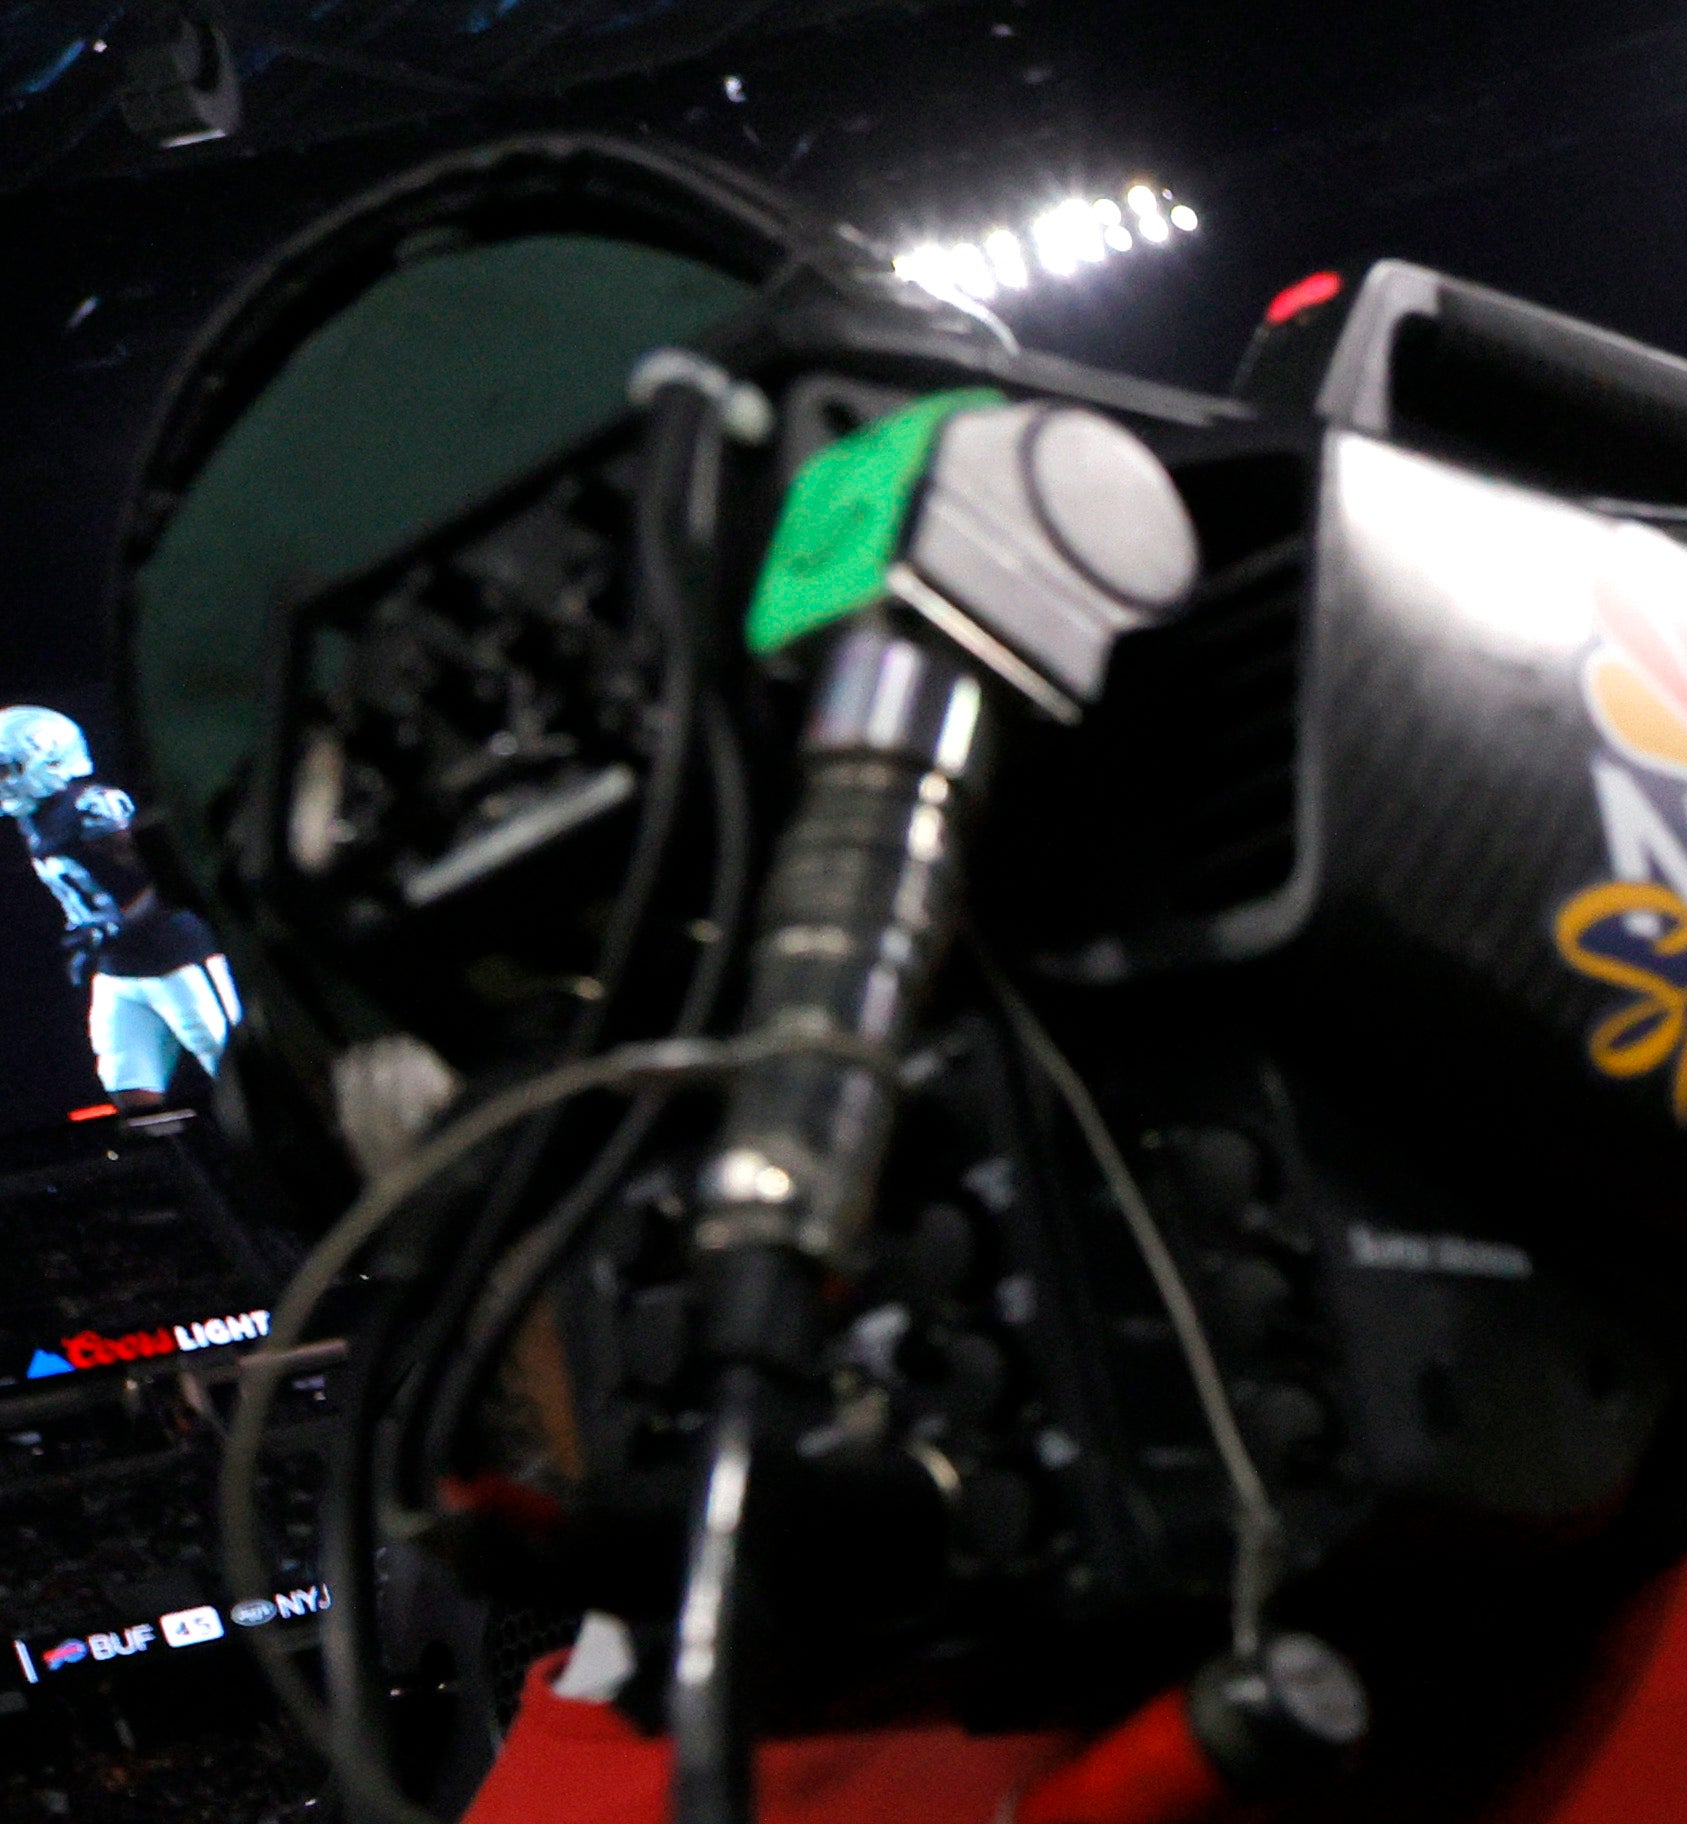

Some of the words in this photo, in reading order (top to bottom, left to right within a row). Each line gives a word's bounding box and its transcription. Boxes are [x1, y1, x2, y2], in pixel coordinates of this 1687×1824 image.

[60, 1328, 177, 1370] Coors
[173, 1310, 270, 1351] LIGHT
[86, 1622, 156, 1661] BUF
[175, 1616, 212, 1637] 45
[274, 1582, 331, 1619] NYJ
